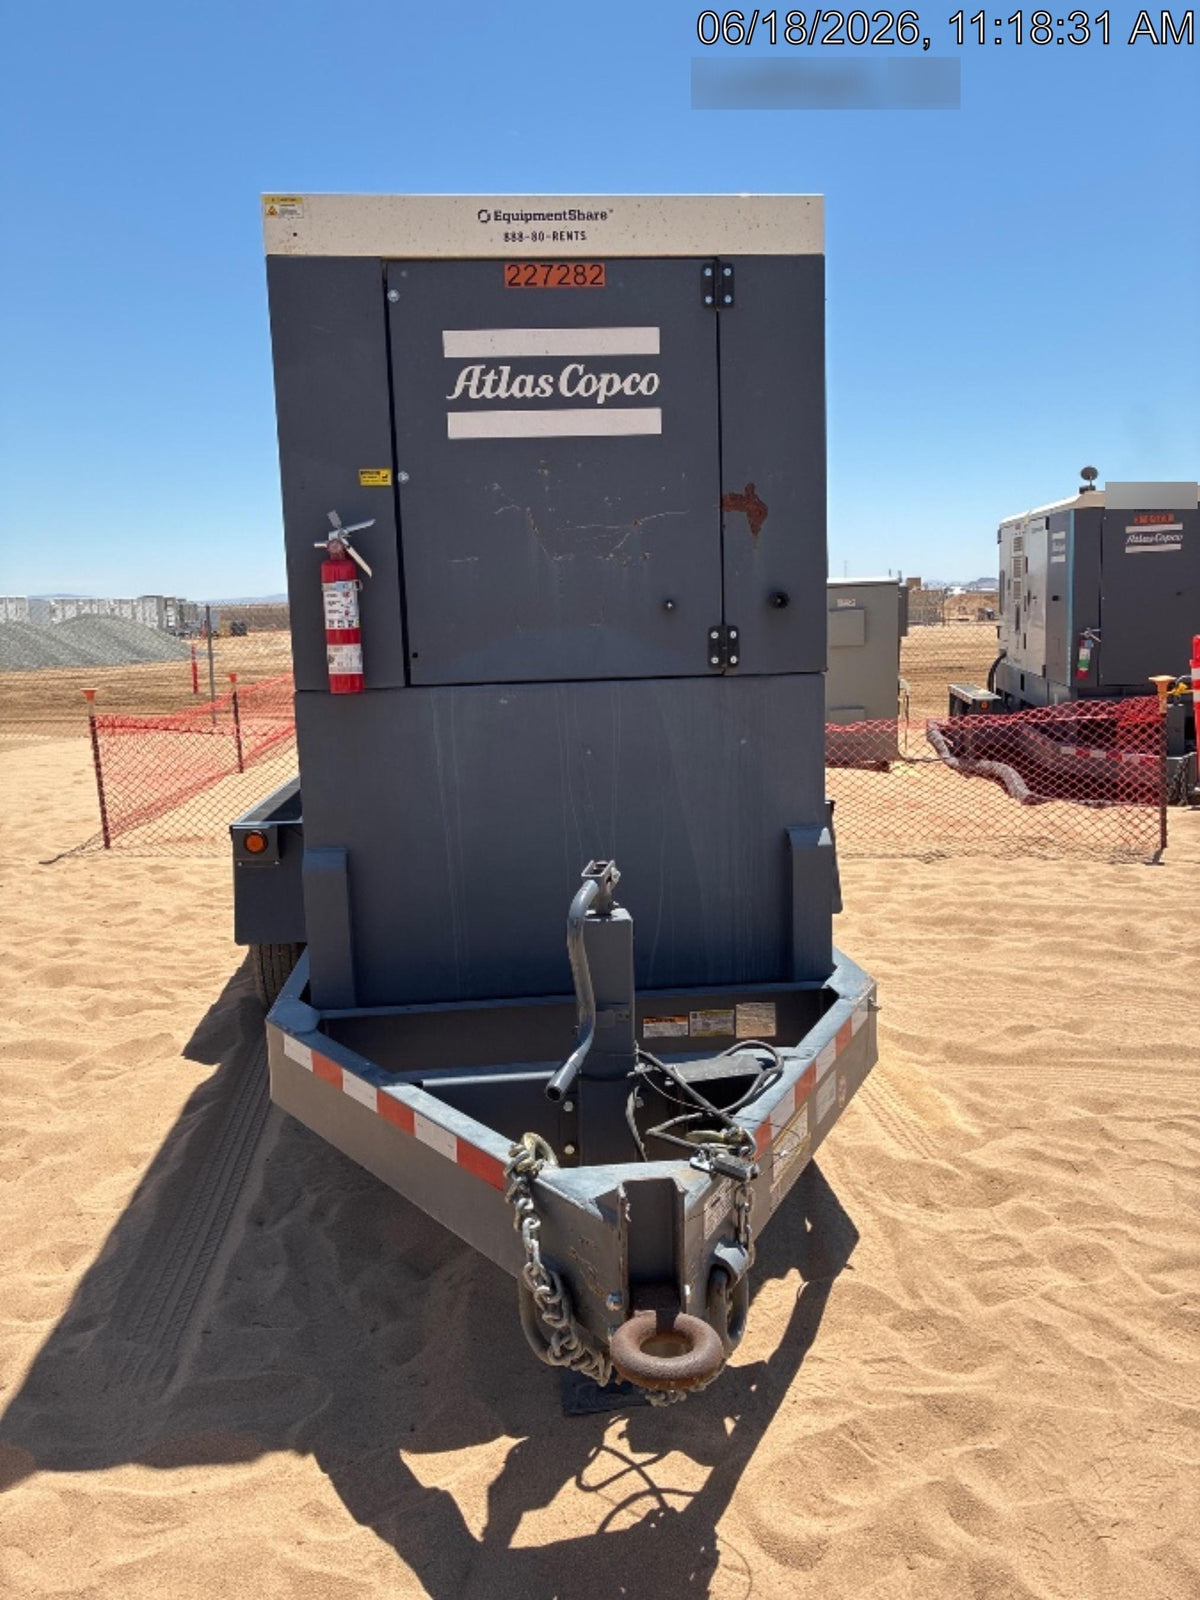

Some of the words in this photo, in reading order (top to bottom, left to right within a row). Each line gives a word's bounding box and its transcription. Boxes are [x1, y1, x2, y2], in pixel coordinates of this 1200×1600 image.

[503, 230, 588, 242] 888-80-RENTS
[506, 264, 604, 287] 227282
[446, 364, 554, 400] Atlas
[558, 363, 661, 405] Copco
